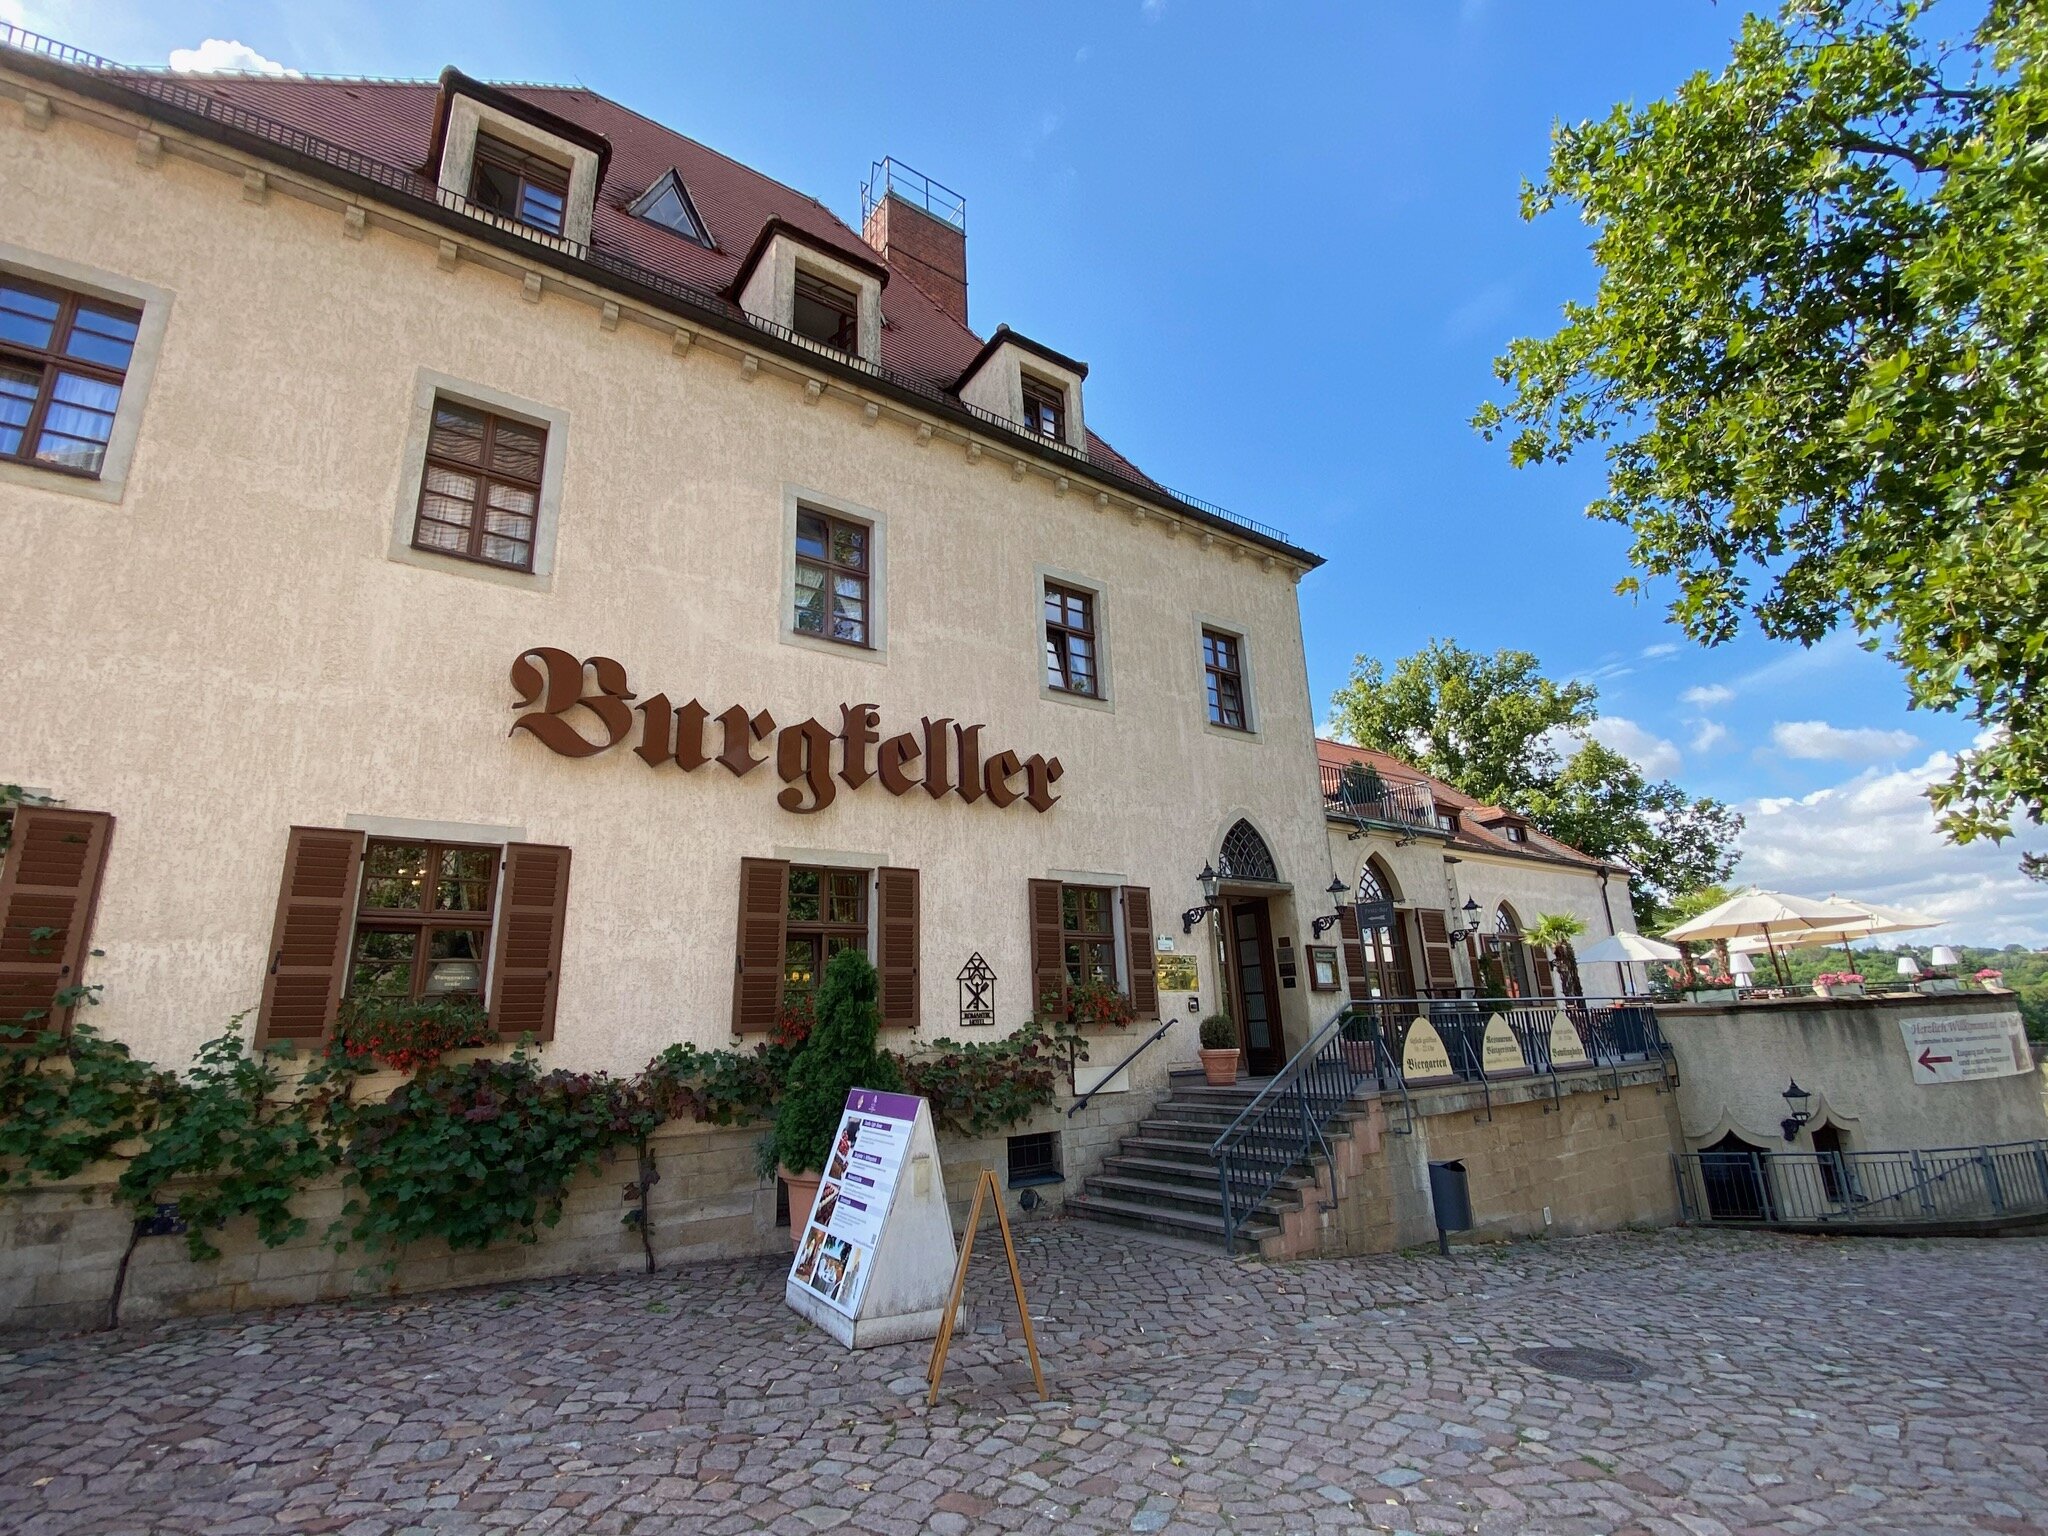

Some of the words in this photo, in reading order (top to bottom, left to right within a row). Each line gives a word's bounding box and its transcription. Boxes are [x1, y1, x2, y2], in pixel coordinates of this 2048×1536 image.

[508, 646, 1064, 814] Burgkeller
[1911, 1021, 1947, 1035] Herzlich
[1406, 1058, 1448, 1073] Biergarten
